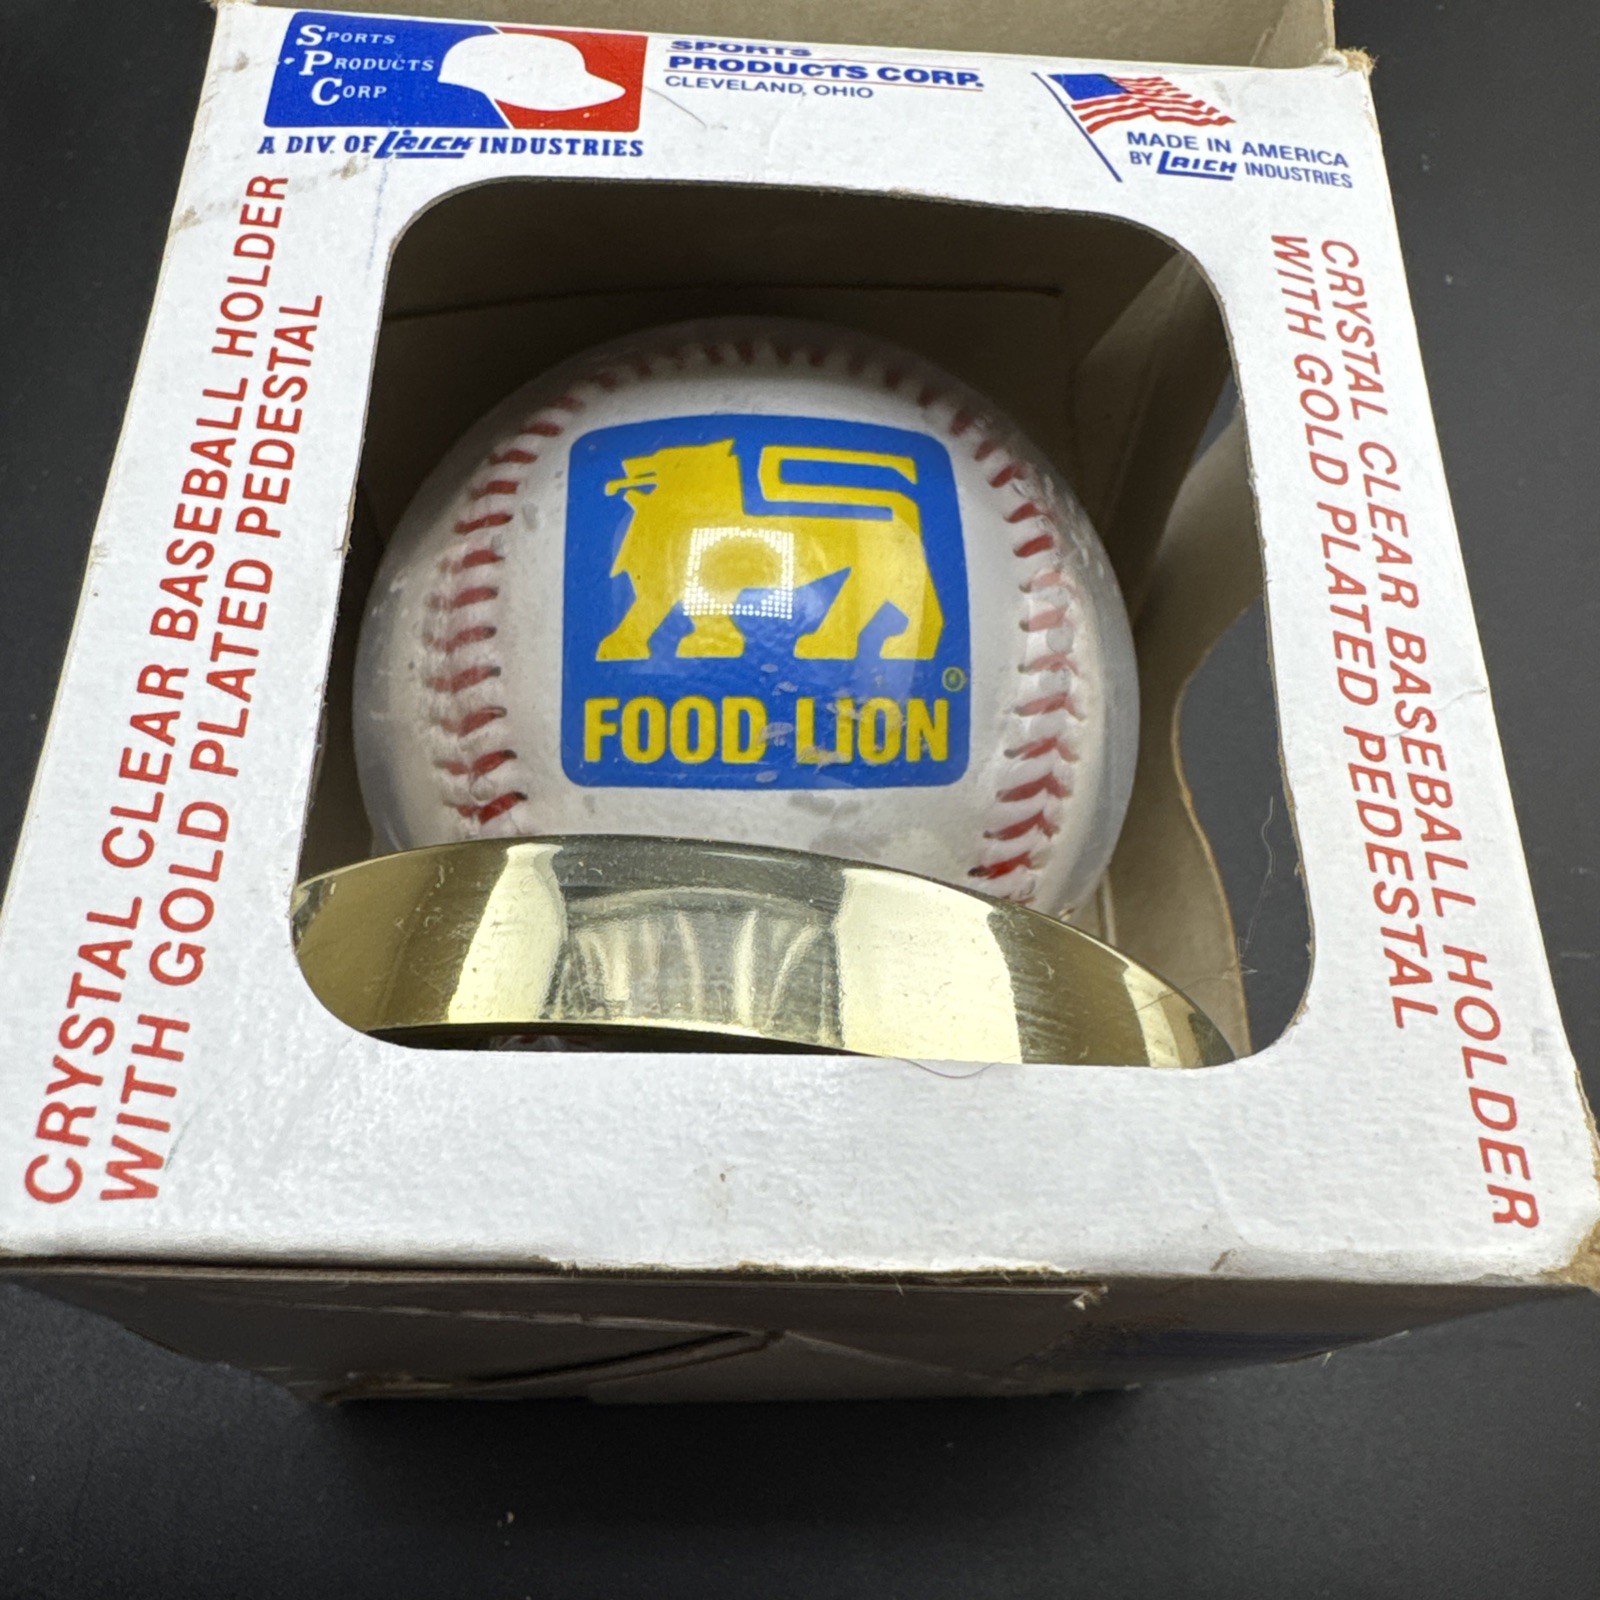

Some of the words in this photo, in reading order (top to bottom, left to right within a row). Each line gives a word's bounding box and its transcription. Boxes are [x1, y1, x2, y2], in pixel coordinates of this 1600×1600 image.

[665, 75, 807, 97] CLEVELAND,
[813, 84, 874, 99] OHIO
[669, 55, 868, 80] PRODUCTS
[877, 67, 985, 88] CORP.
[671, 40, 812, 57] SPORTS
[257, 136, 276, 155] A
[286, 136, 335, 155] DIV.
[344, 135, 377, 154] OF
[479, 136, 644, 157] INDUSTRIES
[1126, 131, 1200, 151] MADE
[1207, 137, 1232, 154] IN
[1241, 141, 1349, 168] AMERICA
[1129, 150, 1153, 166] BY
[1244, 161, 1353, 189] INDUSTRIES
[1271, 234, 1327, 341] WITH
[1321, 239, 1388, 421] CRYSTAL
[235, 295, 323, 538] PEDESTAL
[1294, 353, 1350, 486] GOLD
[1317, 501, 1379, 706] PLATED
[1358, 441, 1420, 609] CLEAR
[24, 896, 143, 1204] CRYSTAL
[101, 664, 189, 869] CLEAR
[149, 377, 249, 641] BASEBALL
[212, 175, 288, 358] HOLDER
[189, 558, 273, 777] PLATED
[584, 696, 768, 764] FOOD
[796, 696, 949, 764] LION
[1386, 627, 1476, 918] BASEBALL
[149, 801, 230, 986] GOLD
[1343, 725, 1438, 1029] PEDESTAL
[100, 1014, 190, 1201] WITH
[1442, 944, 1540, 1229] HOLDER
